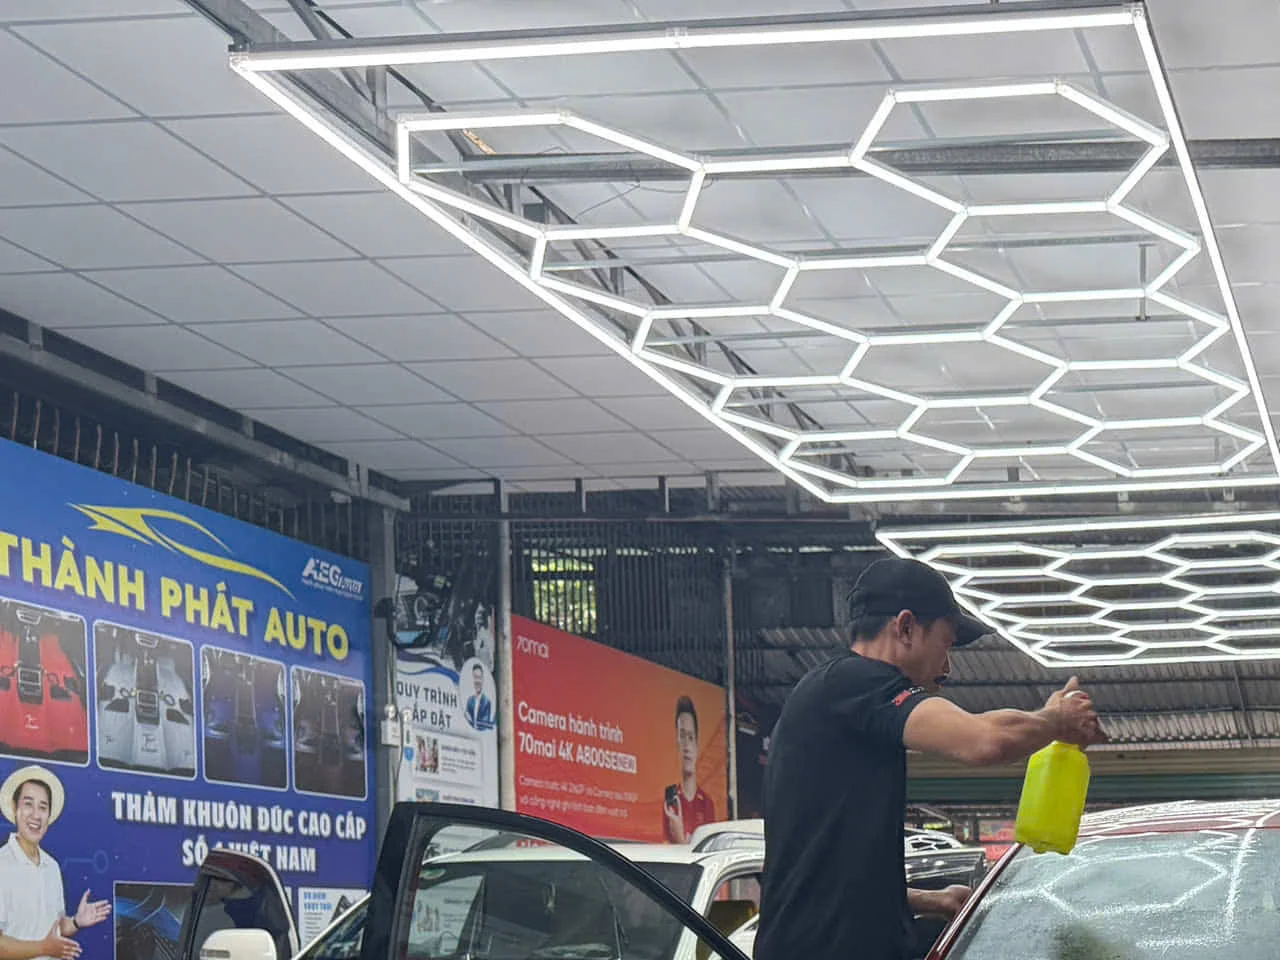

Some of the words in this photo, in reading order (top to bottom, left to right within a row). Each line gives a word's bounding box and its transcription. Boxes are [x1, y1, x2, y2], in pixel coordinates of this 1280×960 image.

[0, 531, 145, 611] THÀNH
[160, 577, 254, 637] PHÁT
[264, 608, 349, 661] AUTO
[424, 687, 458, 708] TRÌNH
[430, 713, 452, 730] ĐẶT
[518, 701, 567, 730] Camera
[568, 713, 598, 737] hành
[518, 732, 557, 758] 70mai
[558, 740, 574, 762] 4K
[112, 791, 177, 825] THẢM
[183, 799, 252, 831] KHUÔN
[257, 805, 295, 835] ĐÚC
[298, 810, 332, 838] CAO
[335, 810, 367, 841] CẤP
[182, 834, 209, 867] SỐ
[276, 845, 316, 873] NAM
